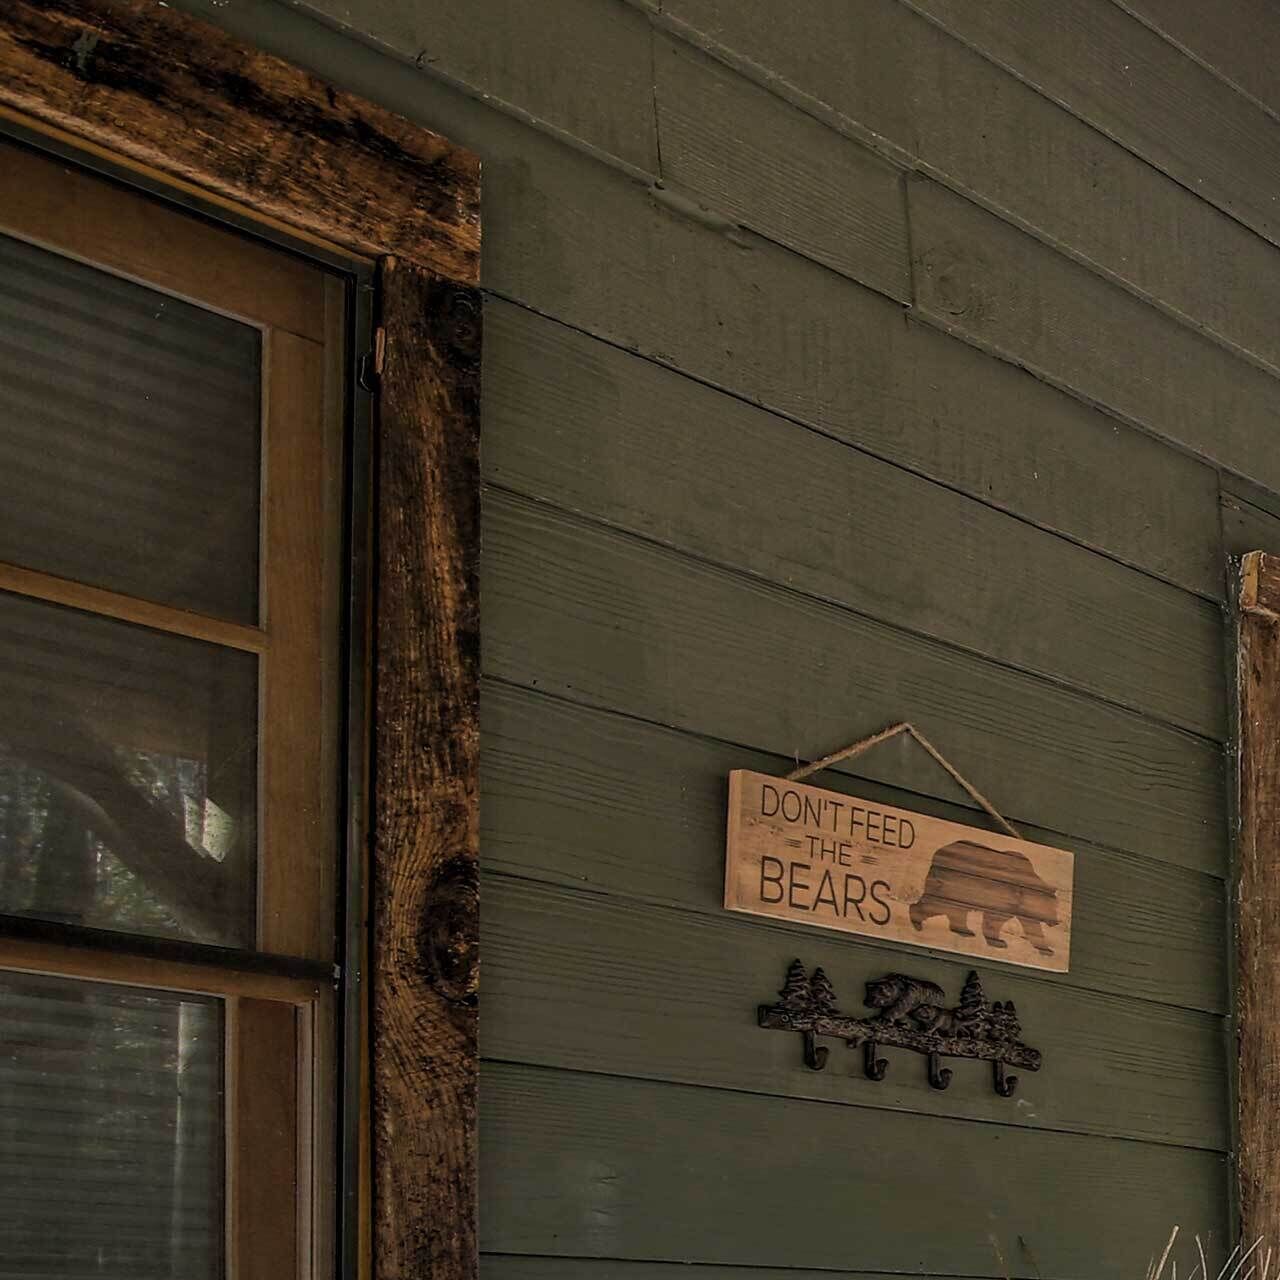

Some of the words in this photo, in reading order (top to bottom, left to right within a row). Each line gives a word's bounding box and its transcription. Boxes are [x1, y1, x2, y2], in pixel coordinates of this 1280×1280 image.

[761, 784, 844, 832] DON'T
[850, 806, 915, 849] FEED
[805, 835, 852, 867] THE
[760, 855, 891, 925] BEARS
